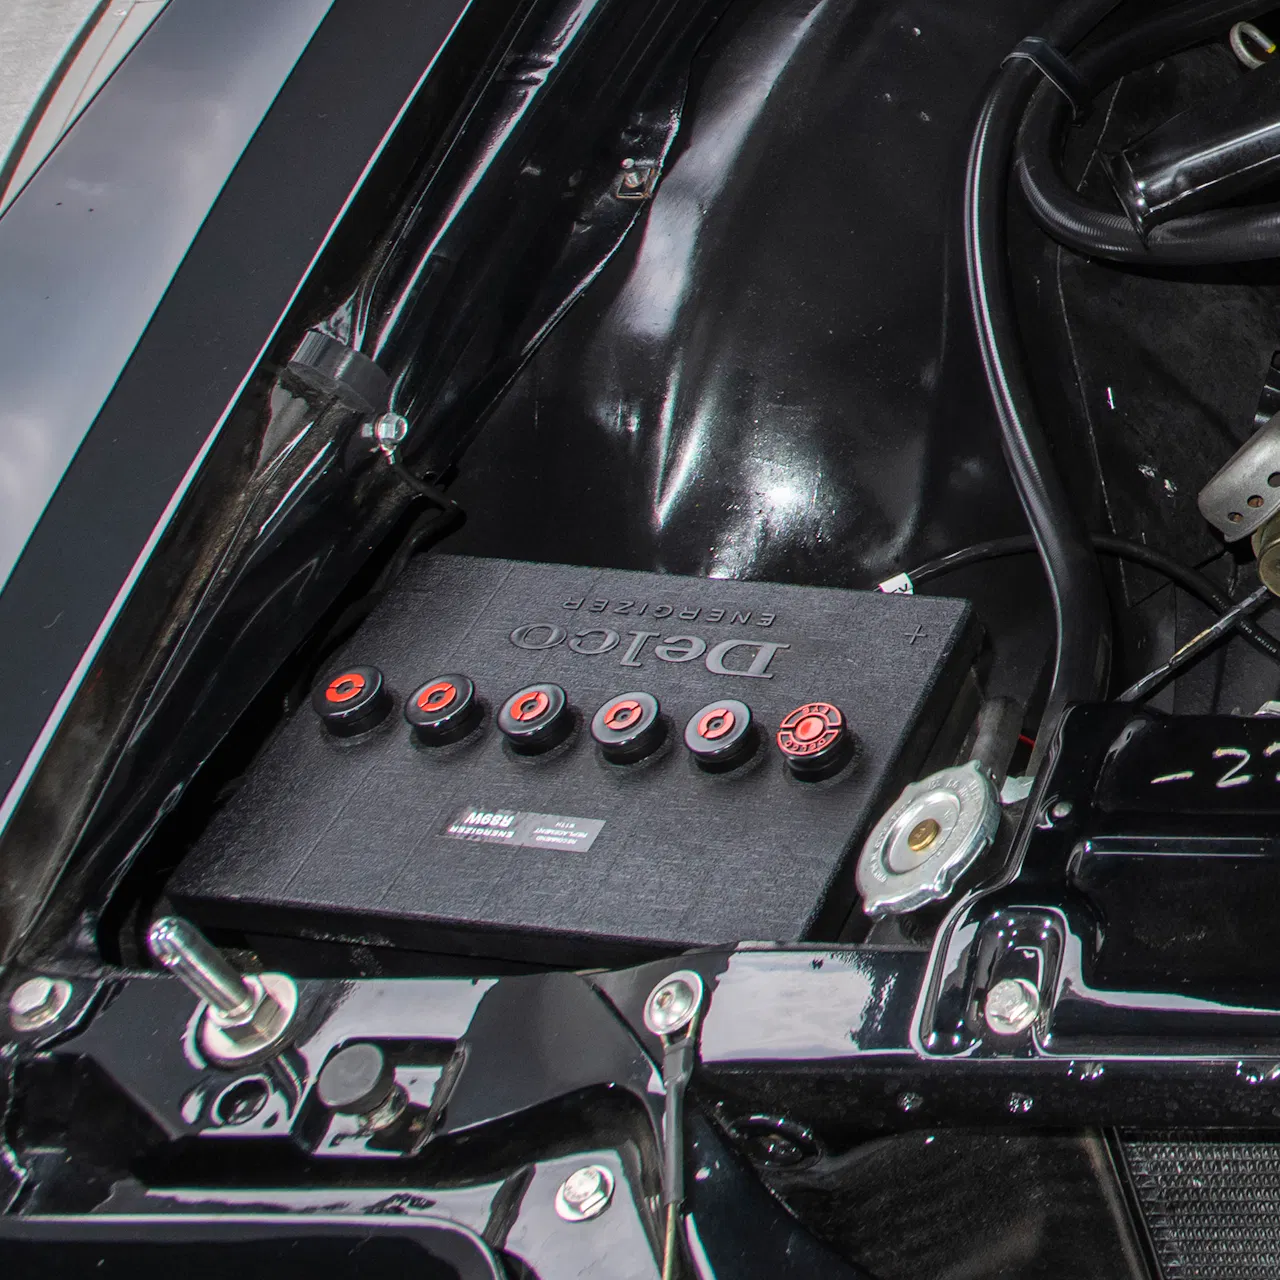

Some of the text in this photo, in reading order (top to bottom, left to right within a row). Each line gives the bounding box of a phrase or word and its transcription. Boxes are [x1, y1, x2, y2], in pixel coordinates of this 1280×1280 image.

[562, 596, 777, 628] ENERGIZER
[509, 622, 791, 680] Delco
[448, 825, 515, 839] ENERGIZER
[464, 812, 515, 828] R89W
